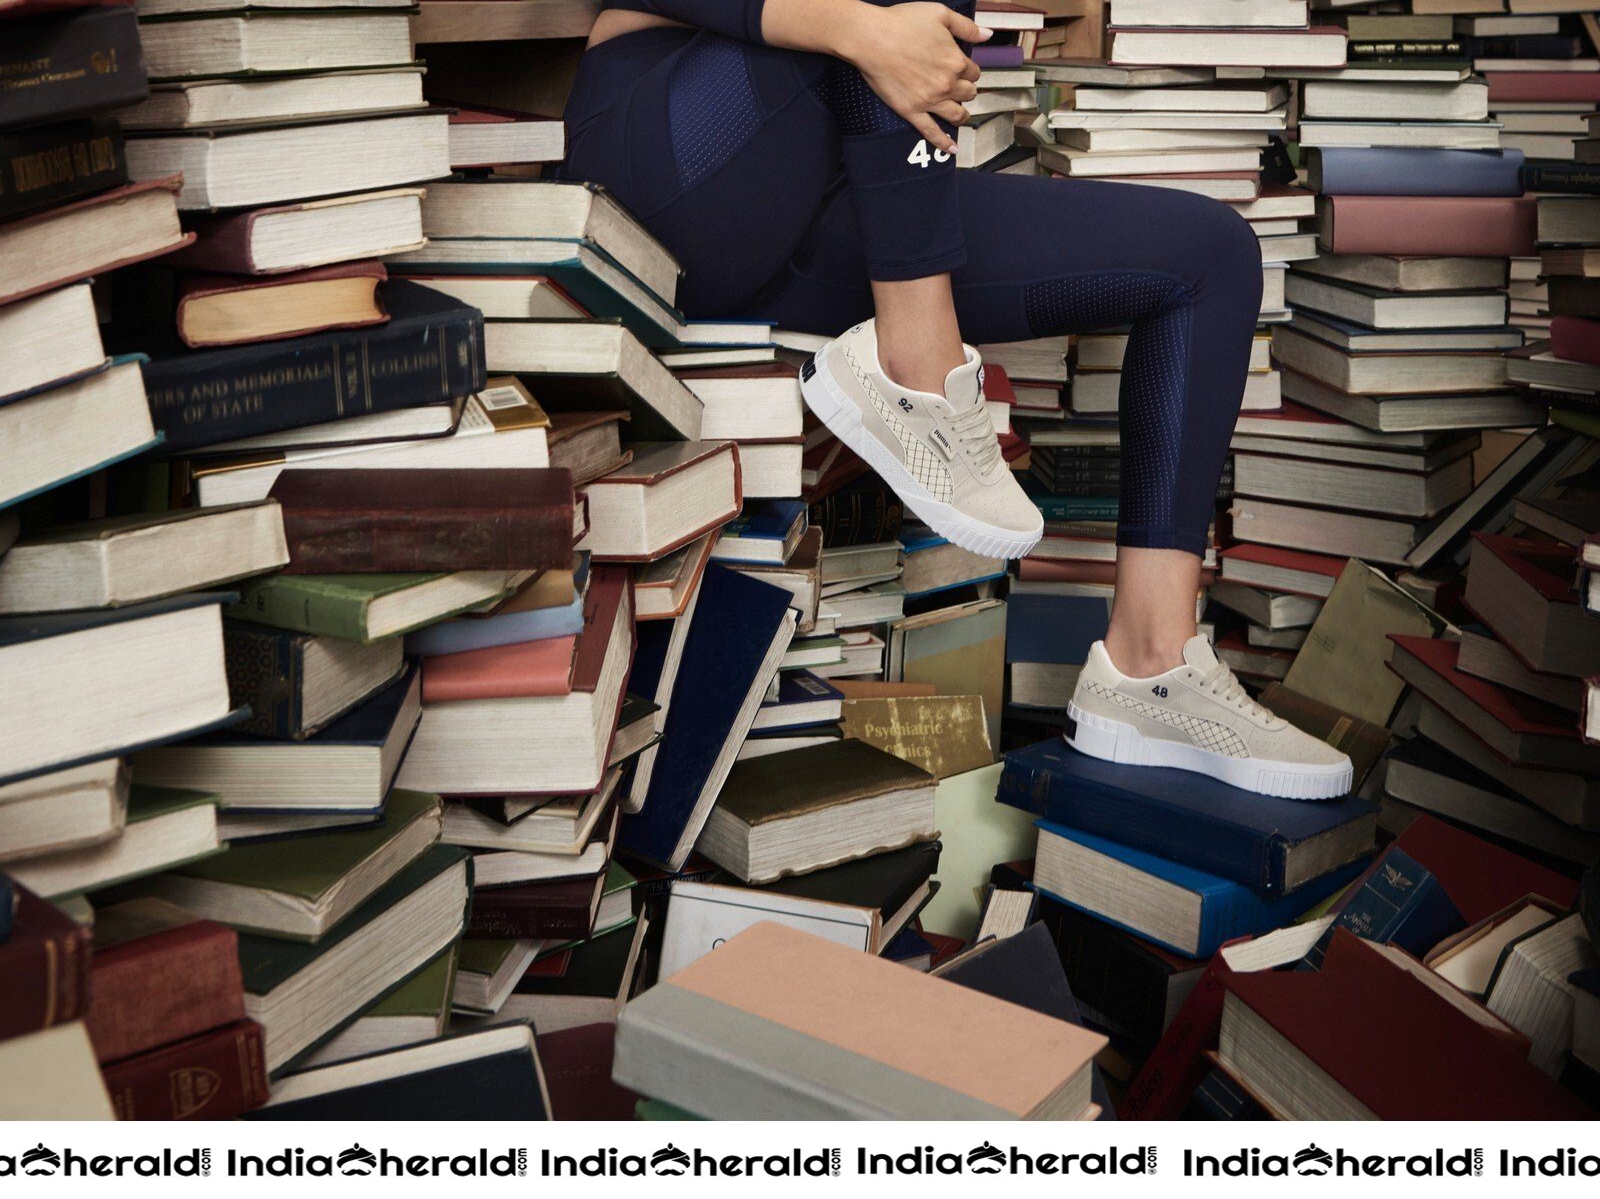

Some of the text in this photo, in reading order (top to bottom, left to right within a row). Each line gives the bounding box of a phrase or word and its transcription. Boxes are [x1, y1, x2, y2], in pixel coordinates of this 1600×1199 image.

[370, 353, 439, 379] COLLINS
[190, 379, 230, 401] AND
[234, 360, 333, 394] MEMORIALS
[182, 395, 264, 425] OF STATE
[898, 398, 914, 414] 92
[1151, 685, 1168, 698] 48
